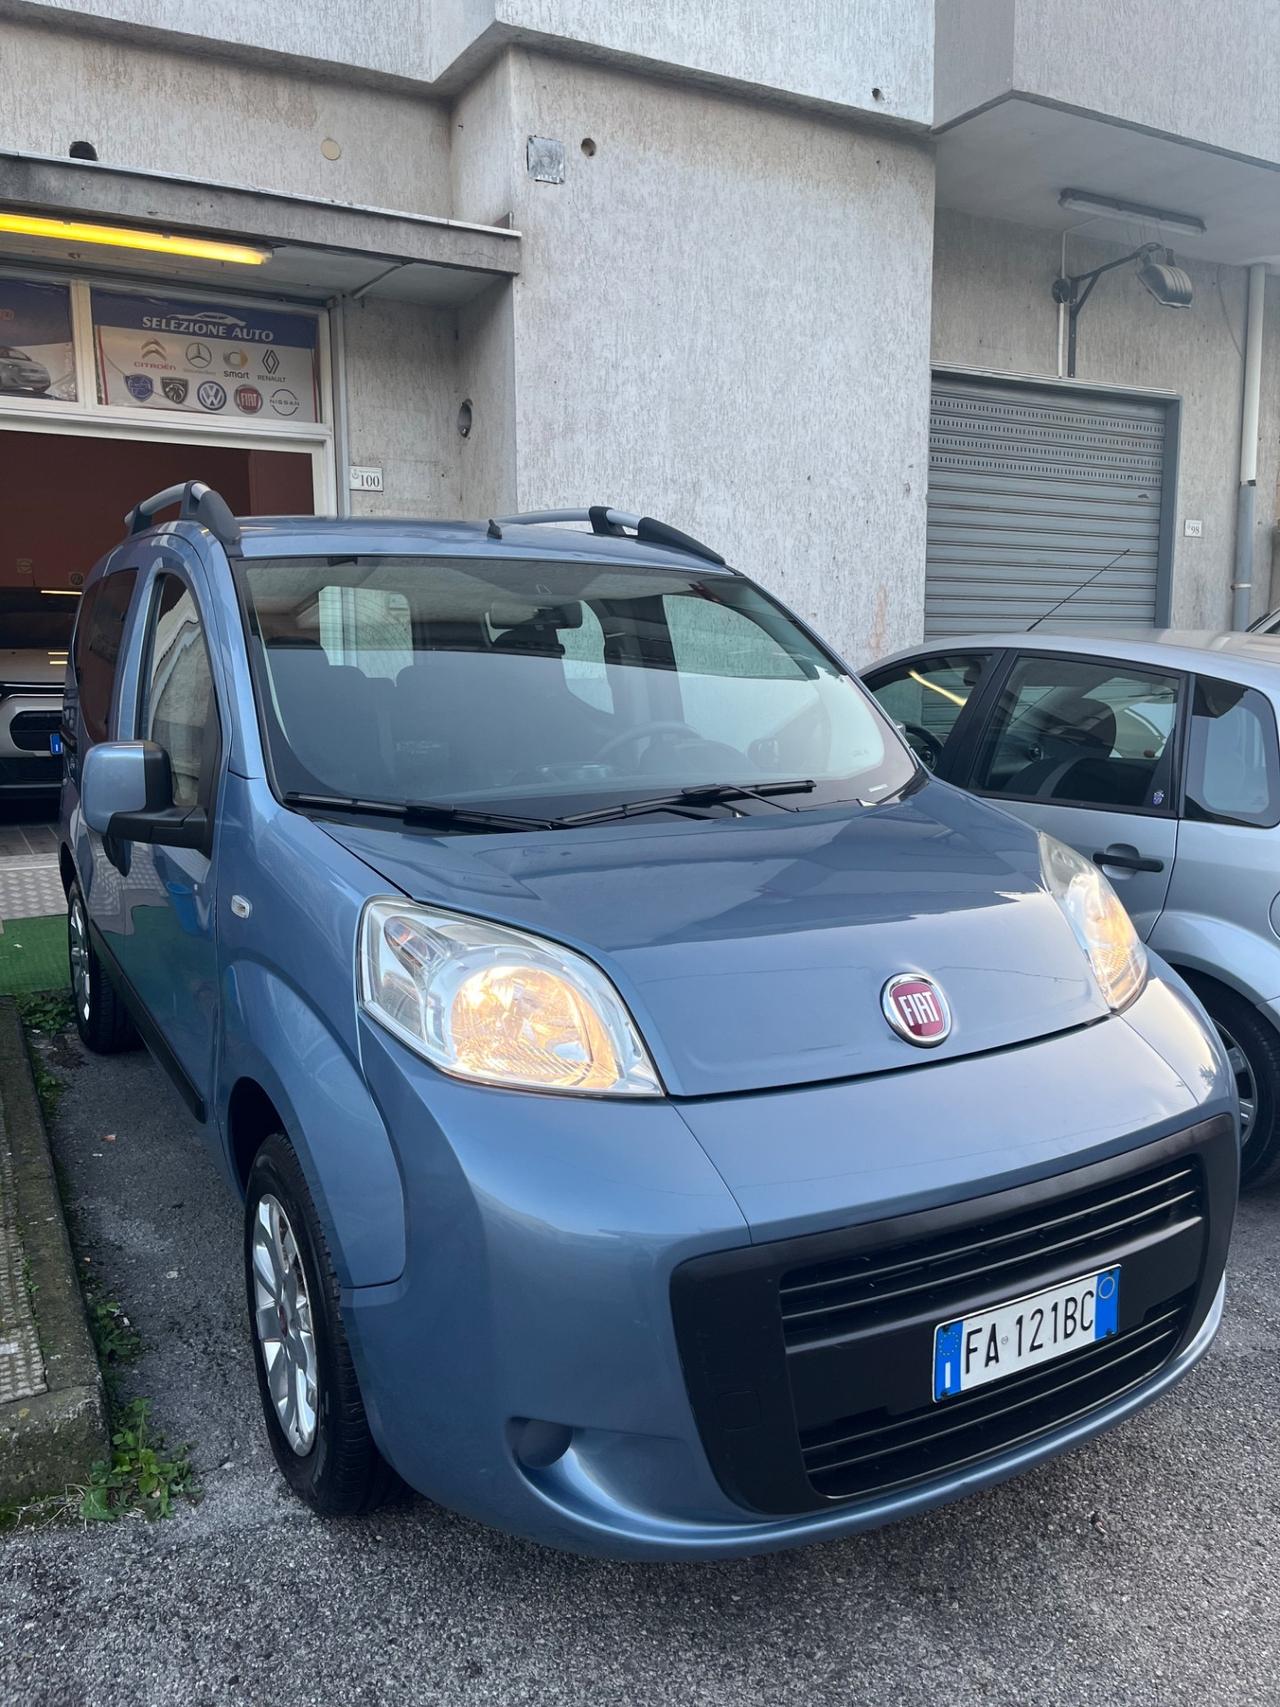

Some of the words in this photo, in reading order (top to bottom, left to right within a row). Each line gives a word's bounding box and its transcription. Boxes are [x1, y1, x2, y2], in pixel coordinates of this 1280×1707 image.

[142, 316, 227, 337] SELEZIONE
[231, 327, 274, 342] AUTO
[223, 370, 250, 379] smart
[257, 374, 286, 383] RENAULT
[269, 399, 300, 407] NISSAN
[361, 474, 380, 488] 100
[897, 991, 940, 1026] FIAT
[965, 1322, 1000, 1374] FA
